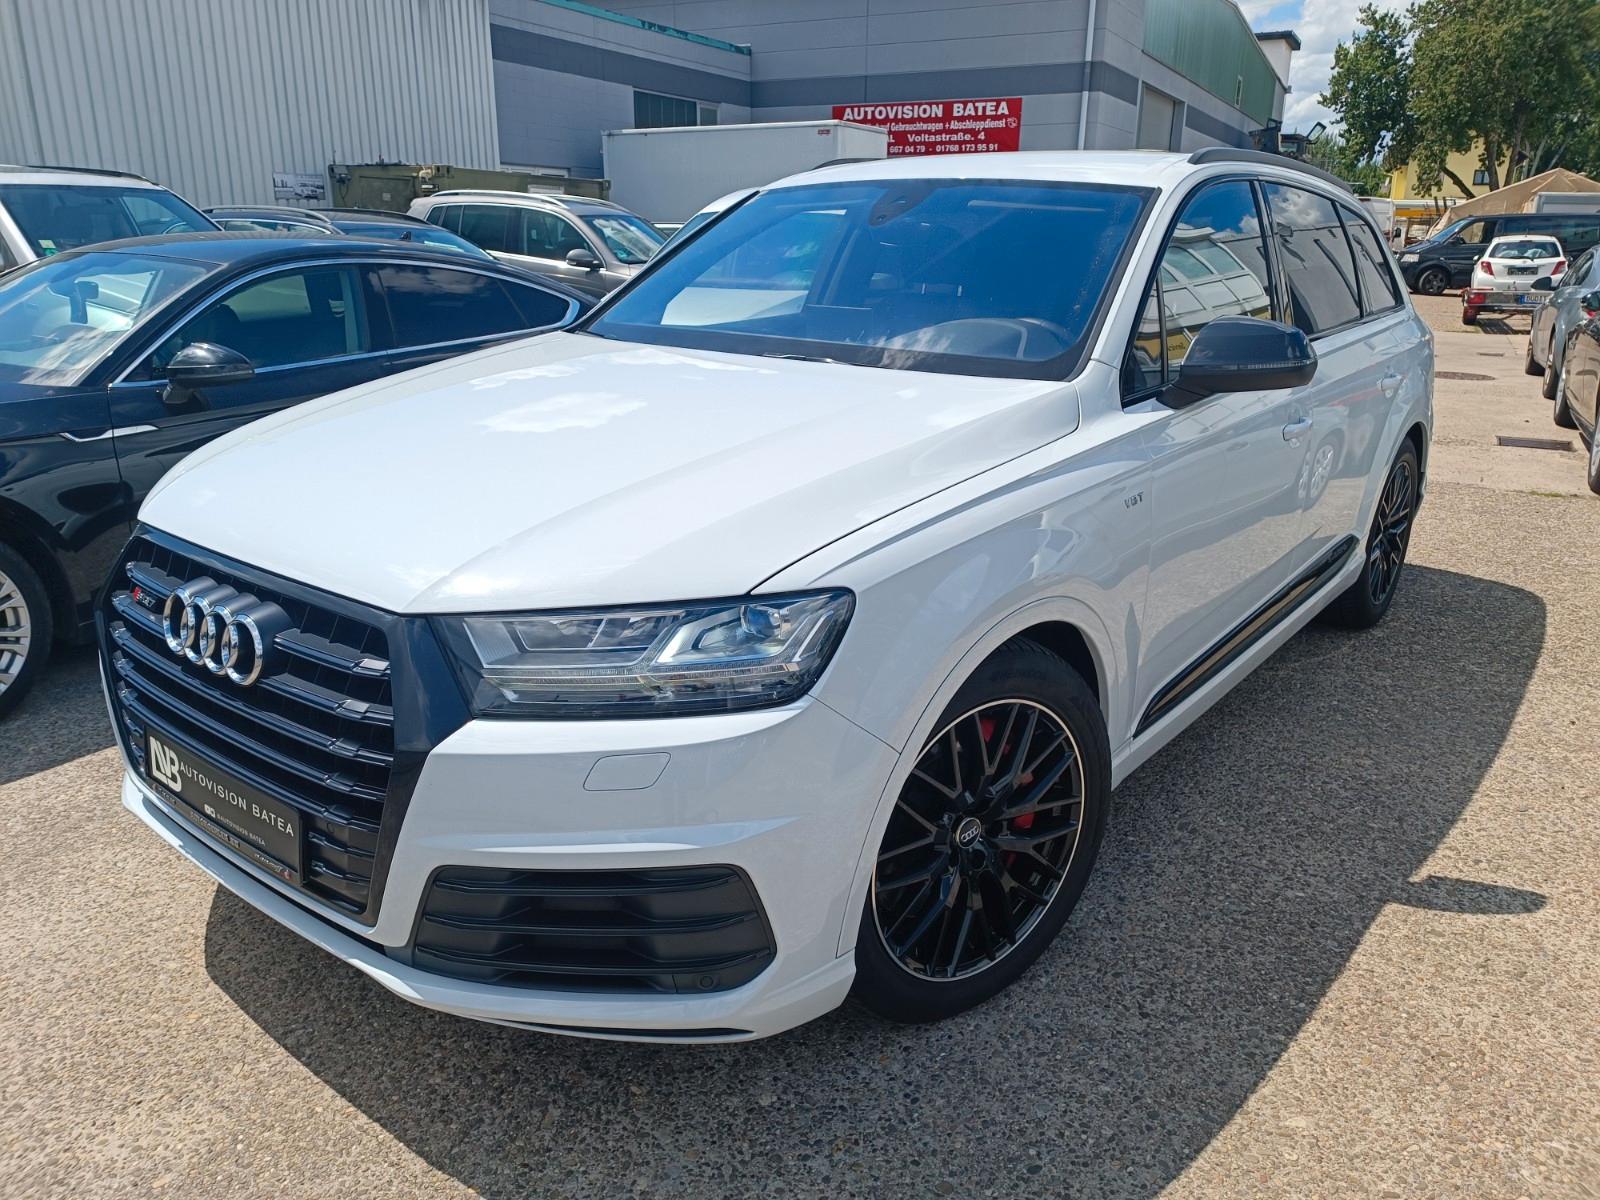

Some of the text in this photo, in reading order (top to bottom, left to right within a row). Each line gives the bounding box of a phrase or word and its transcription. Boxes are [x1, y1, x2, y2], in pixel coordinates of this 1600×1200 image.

[843, 101, 1009, 120] AUTOVISION BATEA
[977, 132, 986, 140] 4
[905, 145, 914, 153] 04
[916, 145, 926, 153] 79
[180, 761, 247, 811] AUTOVISION
[252, 803, 295, 838] BATEA
